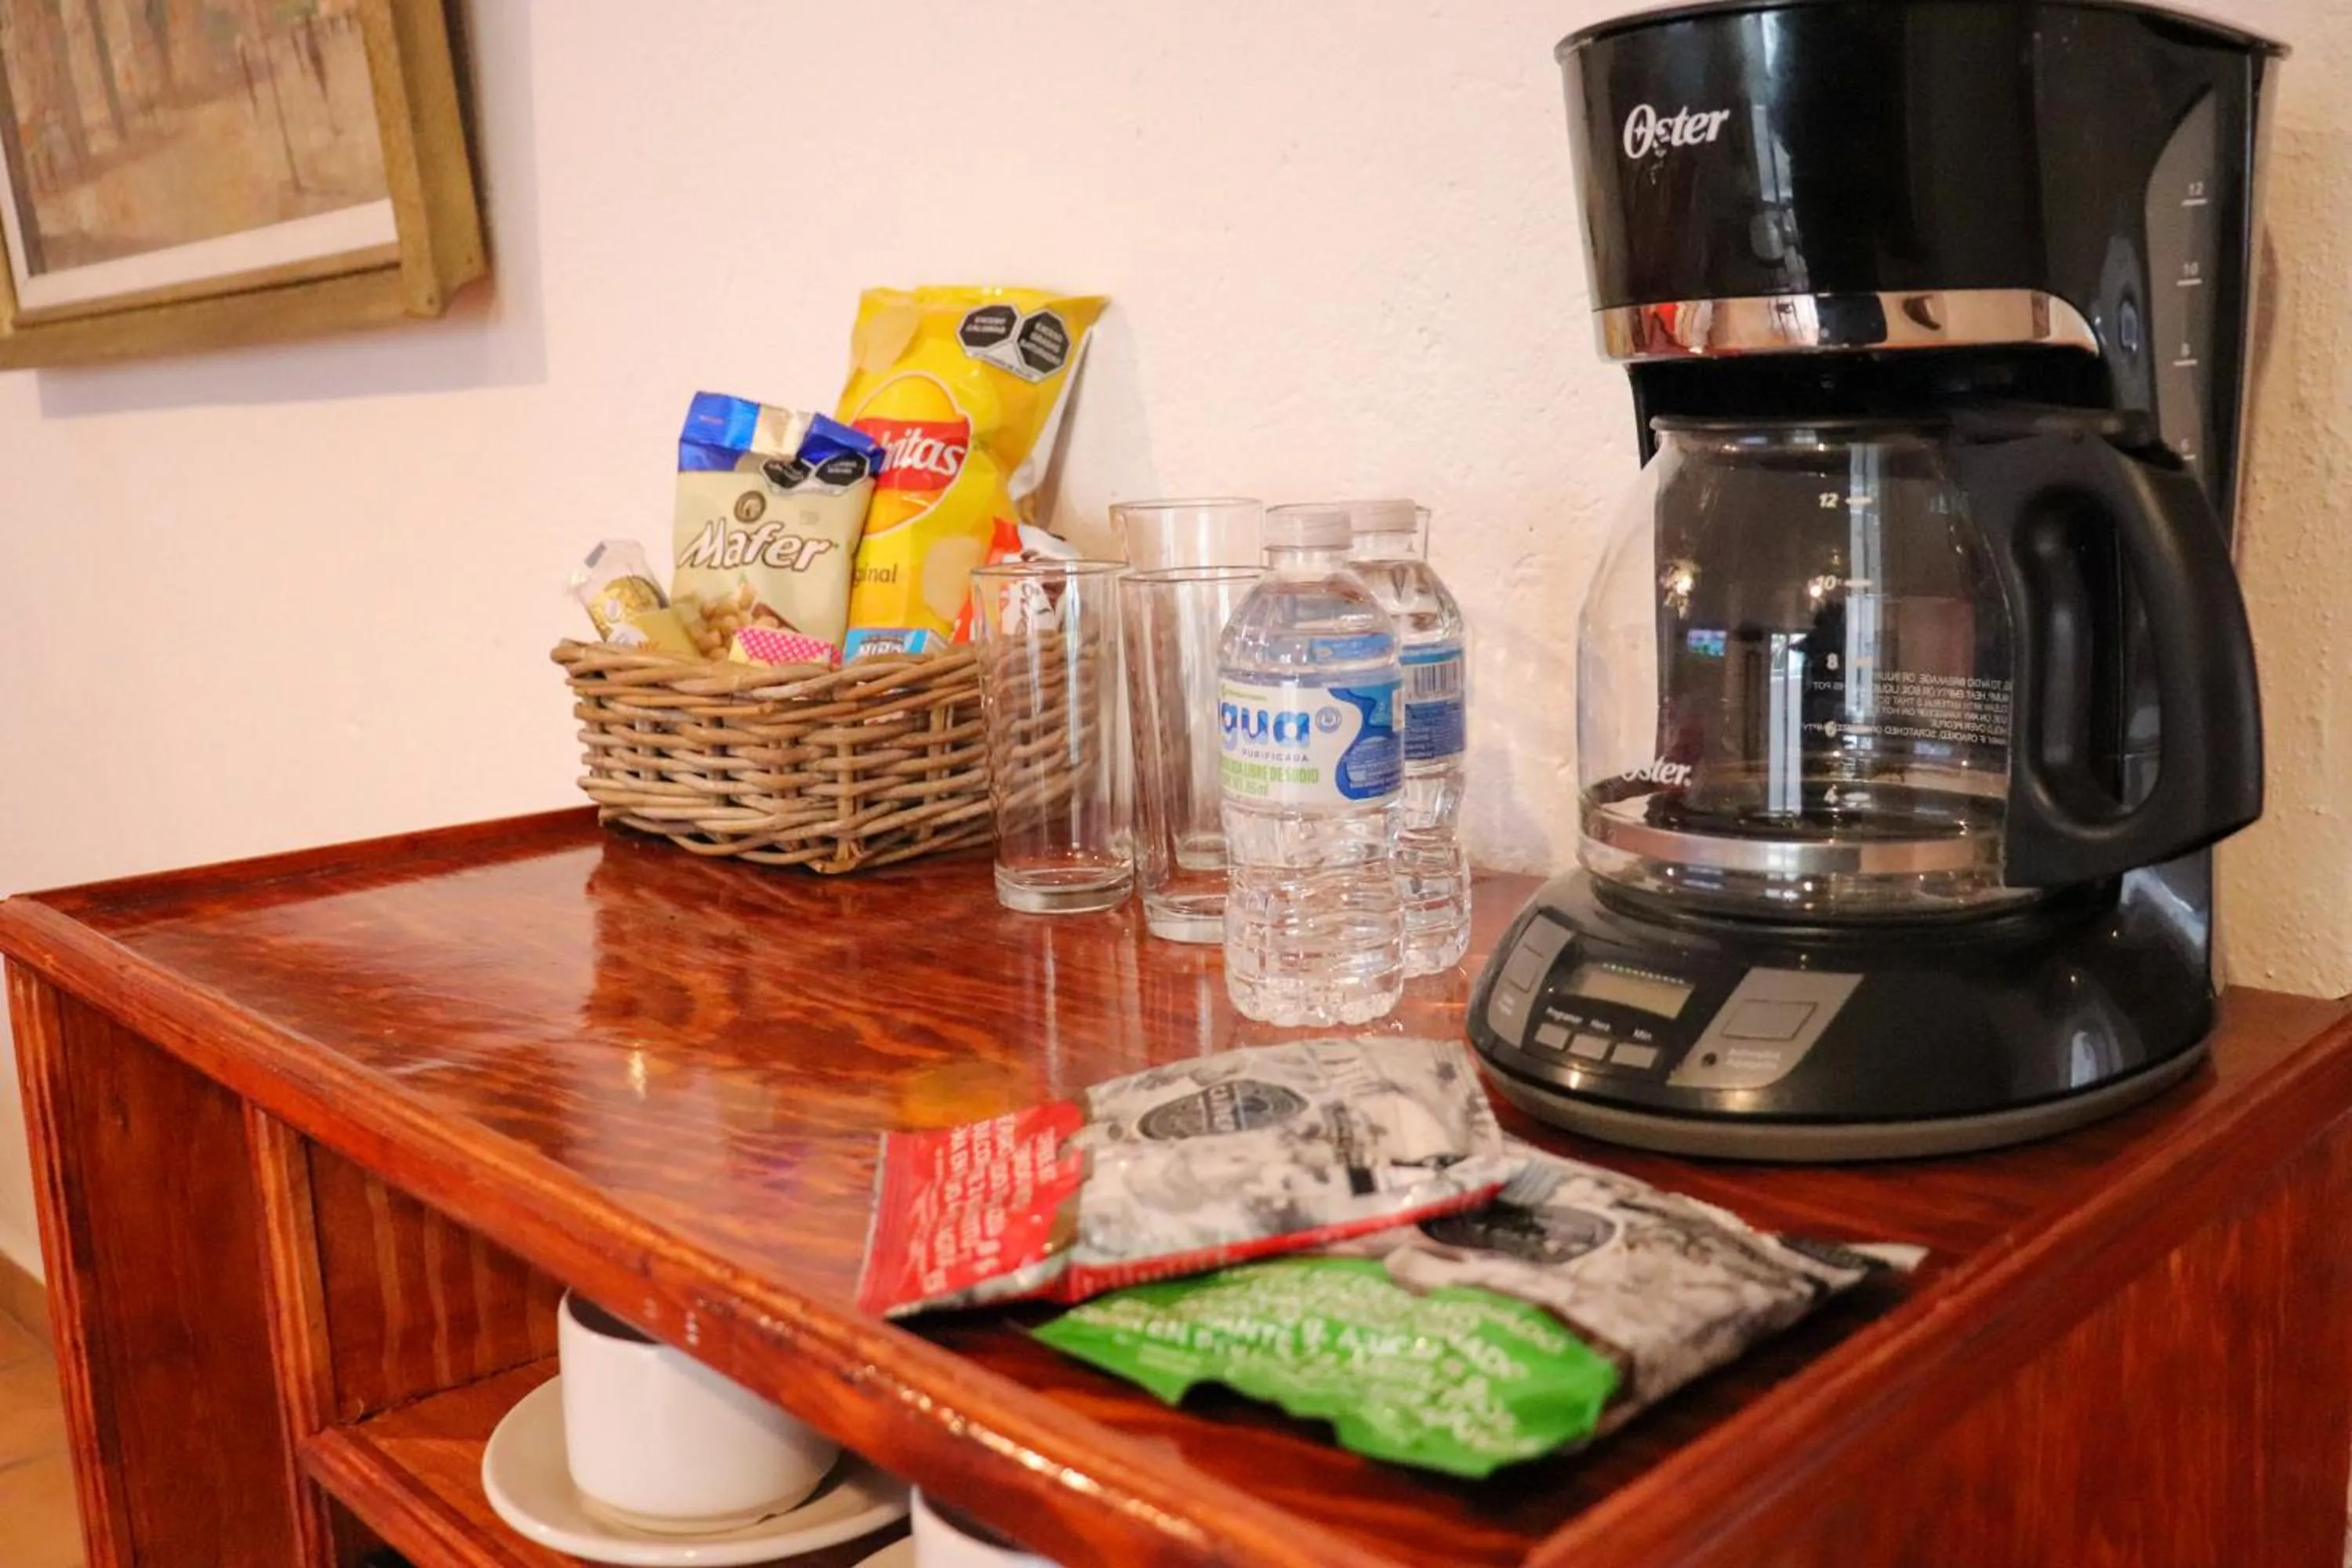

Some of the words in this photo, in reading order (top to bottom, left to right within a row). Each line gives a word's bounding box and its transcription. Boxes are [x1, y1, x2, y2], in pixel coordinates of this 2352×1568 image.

[1623, 103, 1731, 159] Oster
[2188, 182, 2204, 195] 12
[2181, 343, 2190, 357] 8
[1819, 492, 1839, 508] 12
[677, 516, 832, 572] Mafer
[854, 563, 898, 589] ginal
[1817, 575, 1837, 590] 10
[1826, 653, 1838, 670] 8
[1242, 747, 1310, 764] PURIFICADA
